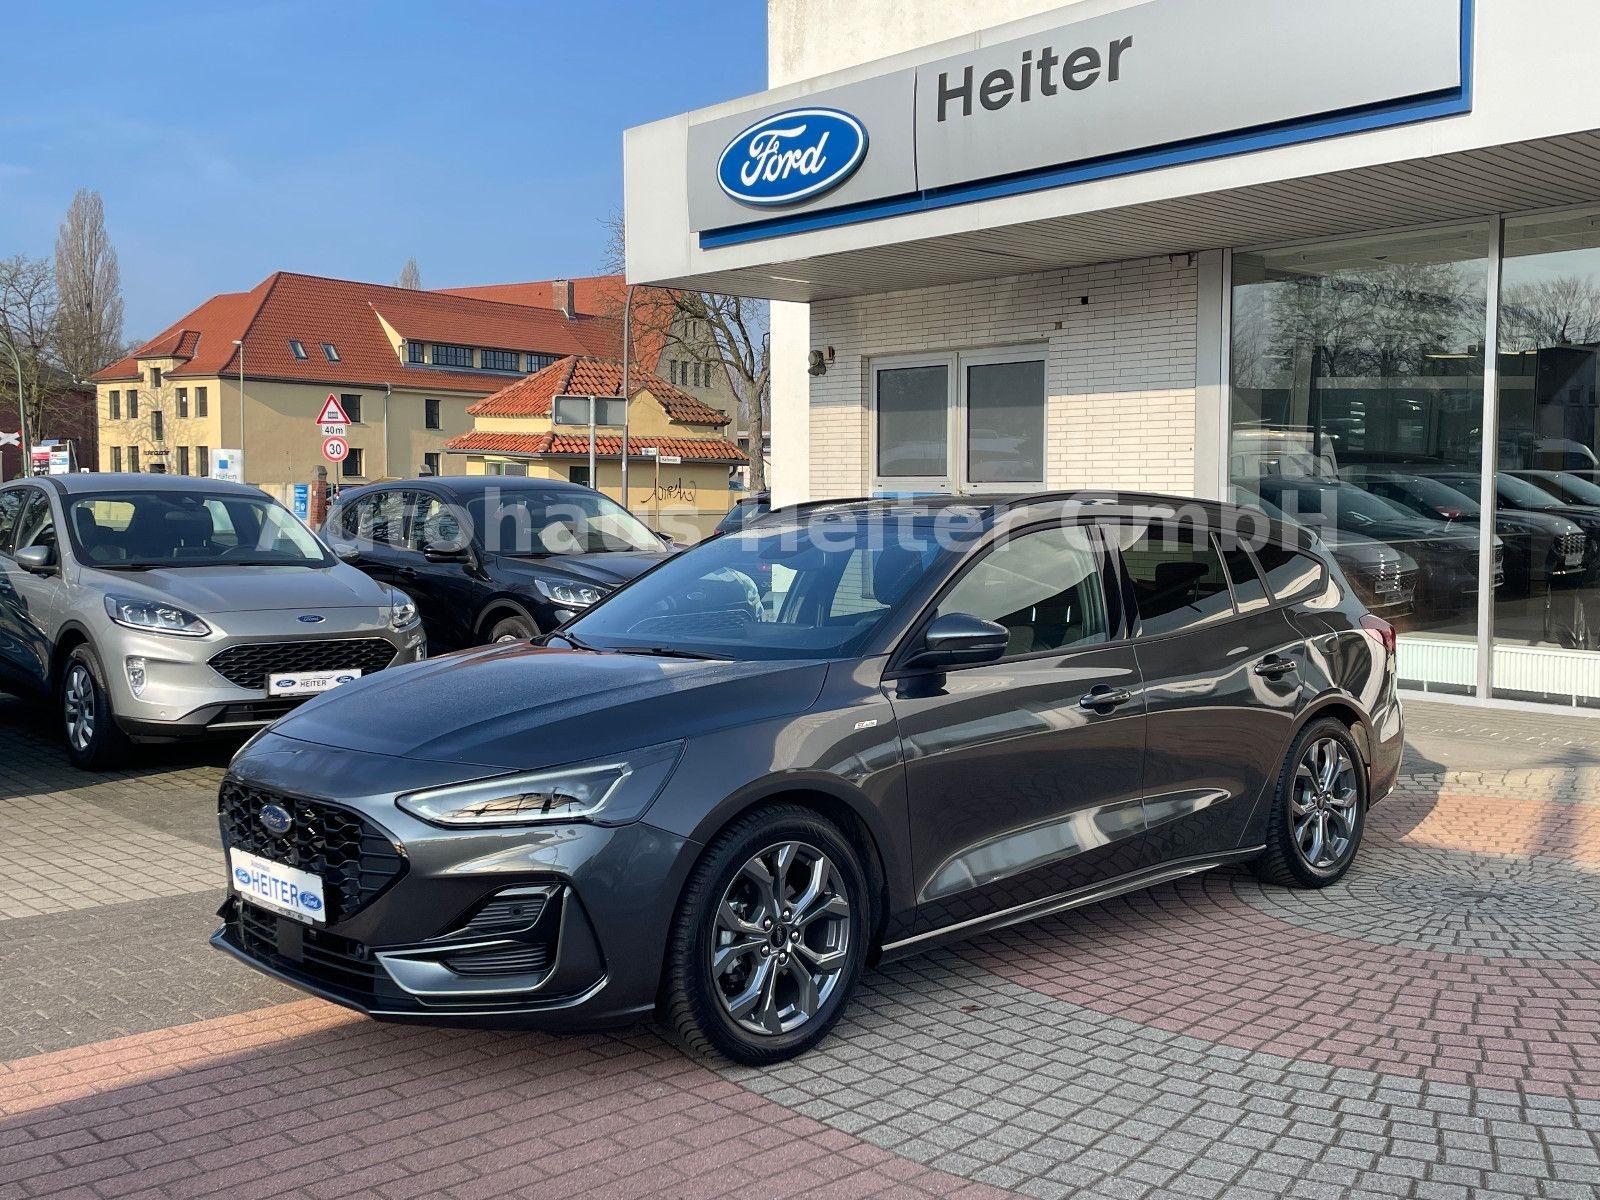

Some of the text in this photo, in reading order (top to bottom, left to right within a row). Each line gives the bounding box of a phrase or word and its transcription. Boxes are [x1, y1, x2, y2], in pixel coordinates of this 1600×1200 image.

[937, 35, 1133, 122] Heiter
[740, 124, 830, 187] Ford
[329, 443, 342, 455] 30
[300, 680, 327, 688] HEITER
[251, 870, 299, 908] HEITER
